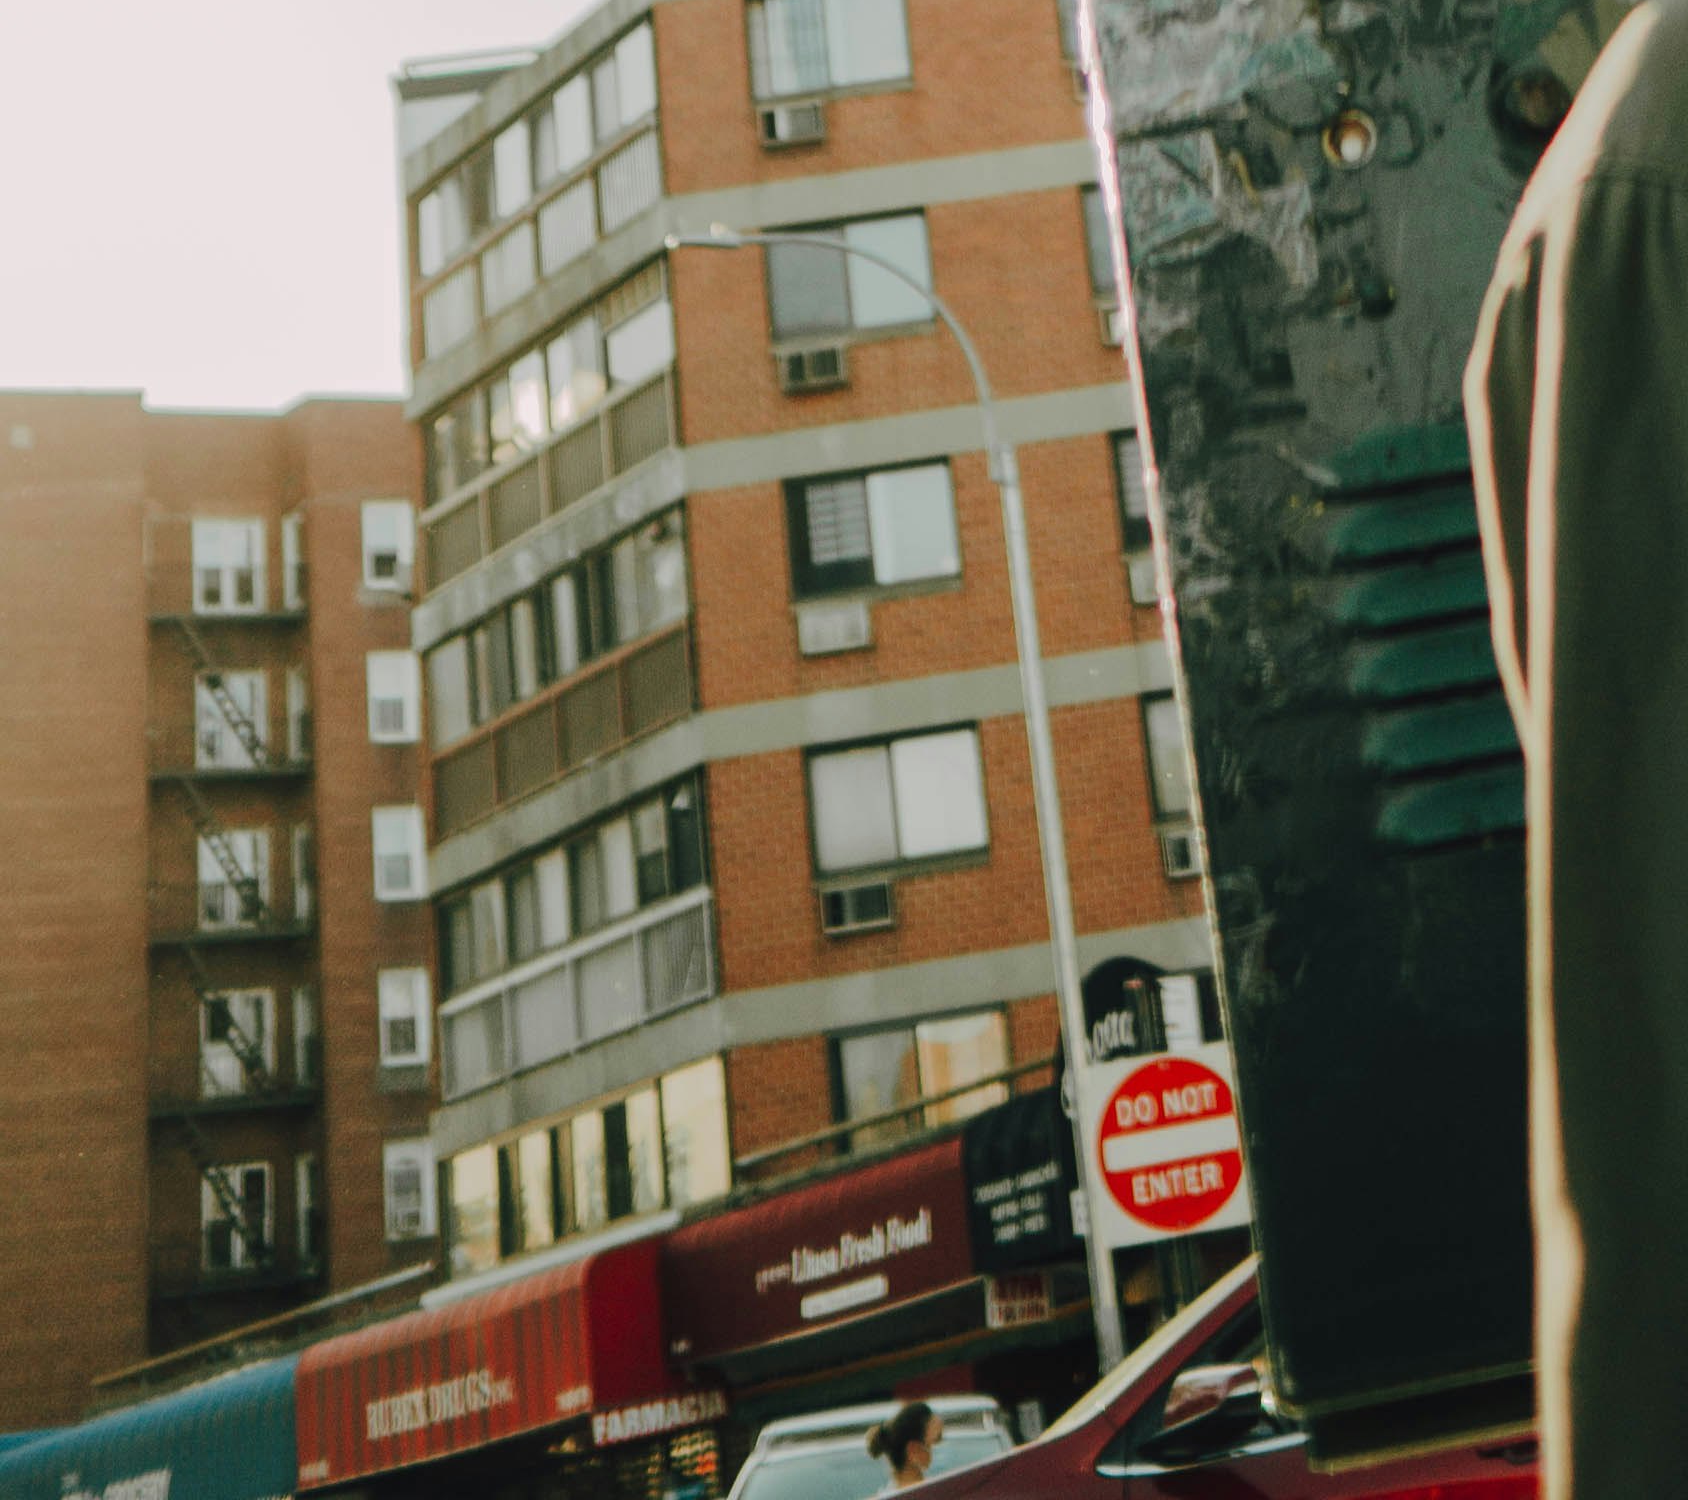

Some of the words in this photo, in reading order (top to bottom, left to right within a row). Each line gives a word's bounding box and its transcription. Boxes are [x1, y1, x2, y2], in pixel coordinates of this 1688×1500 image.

[1114, 1090, 1158, 1129] DO
[1162, 1079, 1218, 1120] NOT
[1131, 1161, 1225, 1206] ENTER
[592, 1391, 727, 1446] FARMACIA
